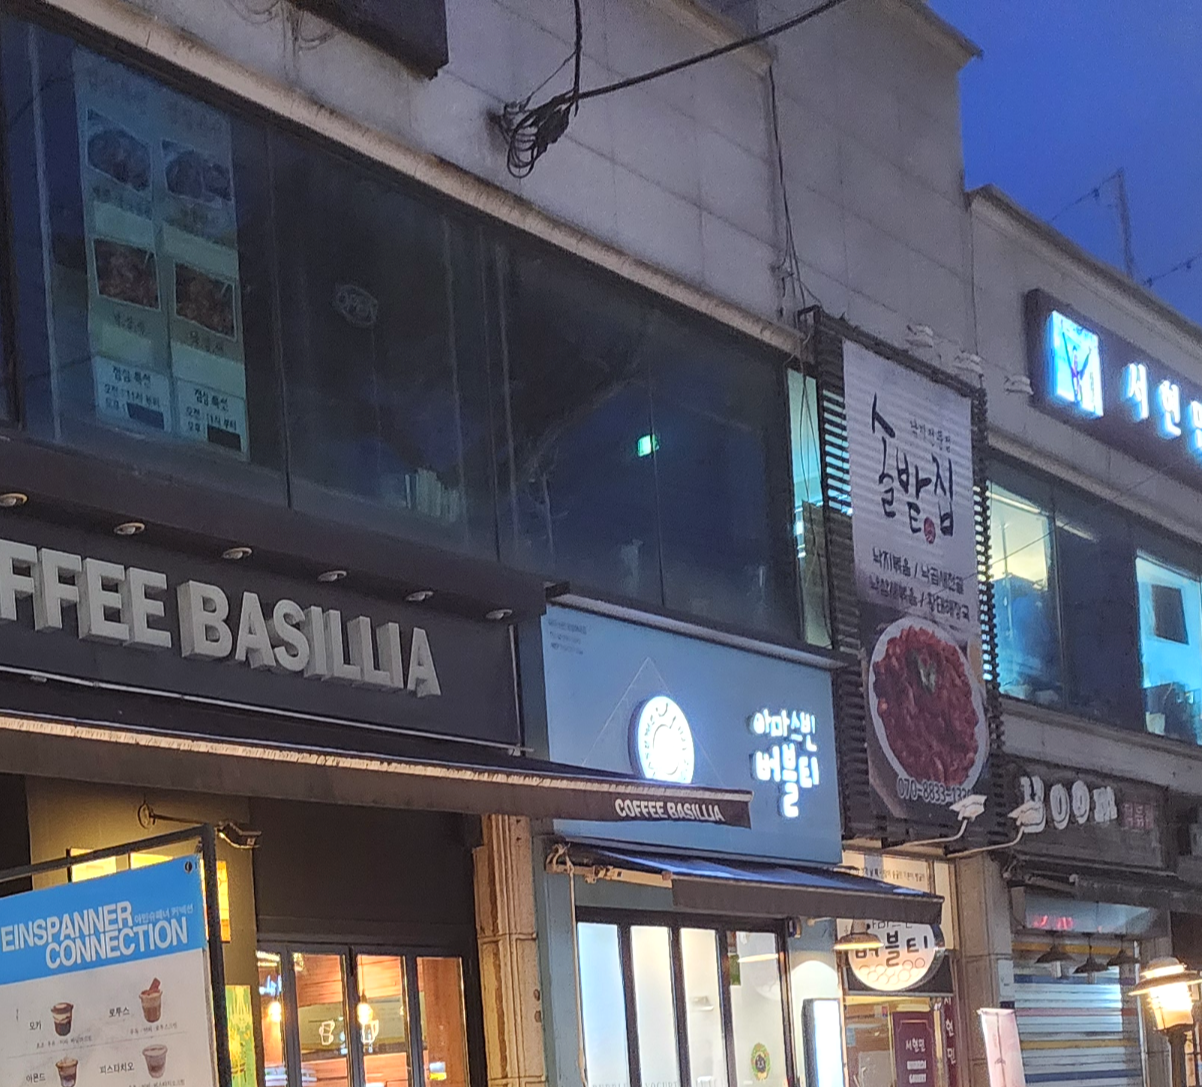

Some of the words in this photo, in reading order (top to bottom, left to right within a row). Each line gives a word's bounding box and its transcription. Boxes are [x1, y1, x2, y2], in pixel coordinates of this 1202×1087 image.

[176, 579, 443, 698] BASILLIA
[750, 708, 818, 752] 아마스빈
[752, 743, 820, 818] 버블티
[614, 798, 668, 819] COFFEE
[666, 802, 726, 822] BASILLIA
[0, 901, 133, 952] EINSPANNER
[45, 916, 188, 969] CONNECTION
[26, 1072, 46, 1084] 아몬드
[99, 1062, 135, 1075] 피스타치오
